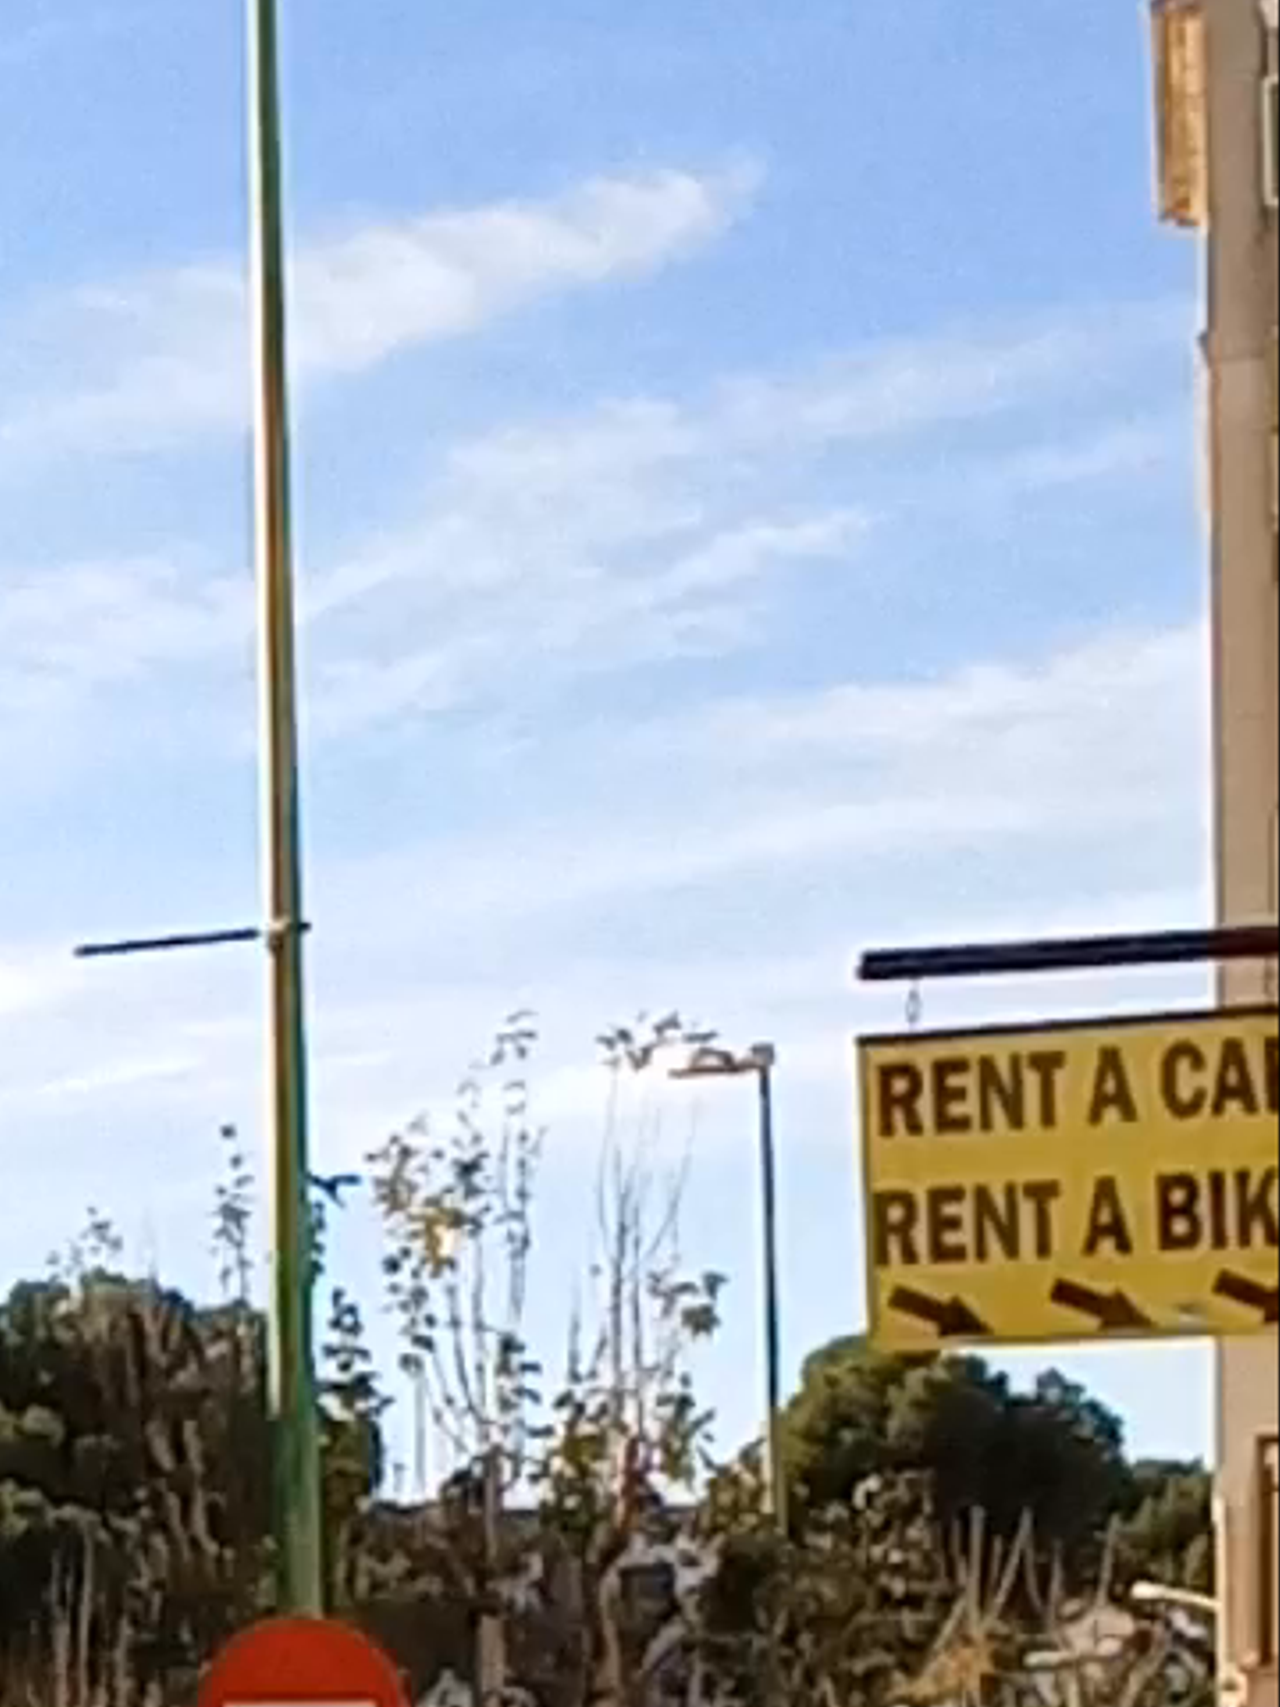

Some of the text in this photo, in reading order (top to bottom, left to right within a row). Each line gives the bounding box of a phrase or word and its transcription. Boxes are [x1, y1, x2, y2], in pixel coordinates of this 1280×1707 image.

[875, 1050, 1066, 1138] RENT
[1088, 1045, 1138, 1127] A
[873, 1179, 1061, 1267] RENT
[1082, 1175, 1133, 1258] A
